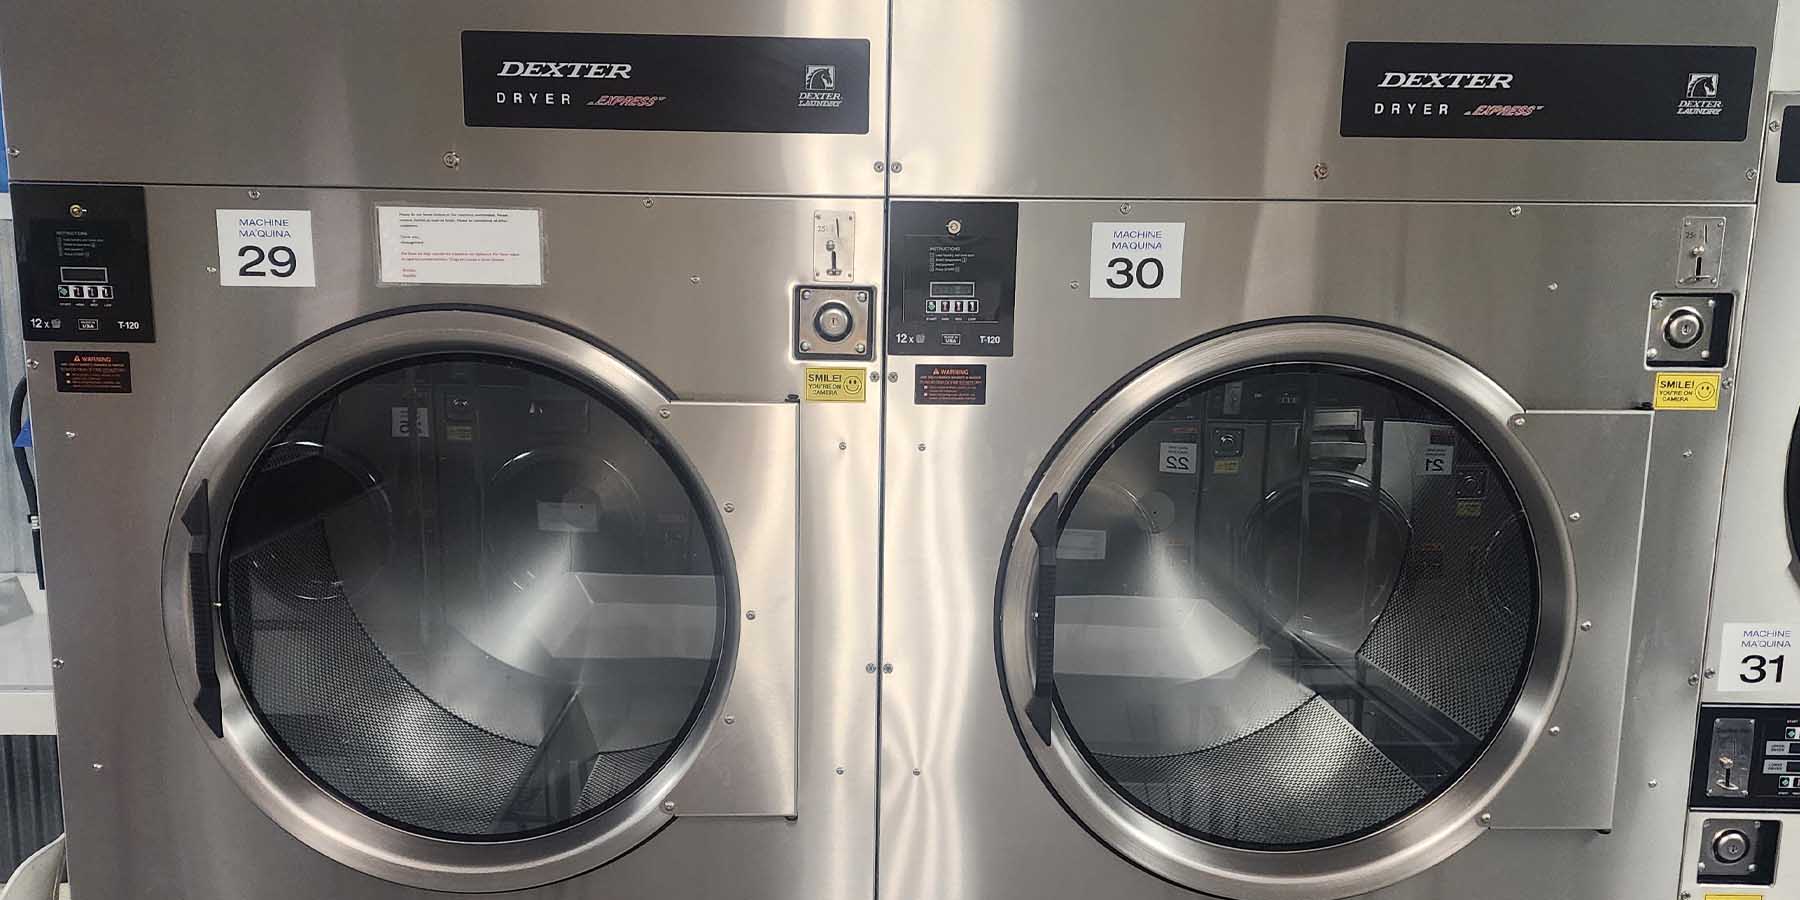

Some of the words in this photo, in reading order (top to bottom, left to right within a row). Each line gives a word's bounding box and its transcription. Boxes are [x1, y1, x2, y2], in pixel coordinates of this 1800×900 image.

[497, 62, 632, 79] DEXTER
[1377, 72, 1513, 89] DEXTER
[496, 92, 571, 105] DRYER
[595, 95, 658, 107] EXPRESS
[799, 92, 842, 100] DEXTER
[1678, 100, 1722, 108] DEXTER
[1374, 103, 1448, 116] DRYER
[1471, 105, 1535, 117] EXPRESS
[239, 219, 289, 227] MACHINE
[1113, 231, 1163, 239] MACHINE
[238, 245, 297, 278] 29
[1106, 257, 1164, 289] 30
[30, 318, 43, 329] 12
[118, 321, 140, 330] T-120
[896, 333, 908, 344] 12
[980, 335, 1001, 344] T-120
[808, 373, 843, 383] SMILE!
[1660, 380, 1695, 389] SMILE!
[1743, 630, 1791, 638] MACHINE
[1739, 655, 1785, 684] 31
